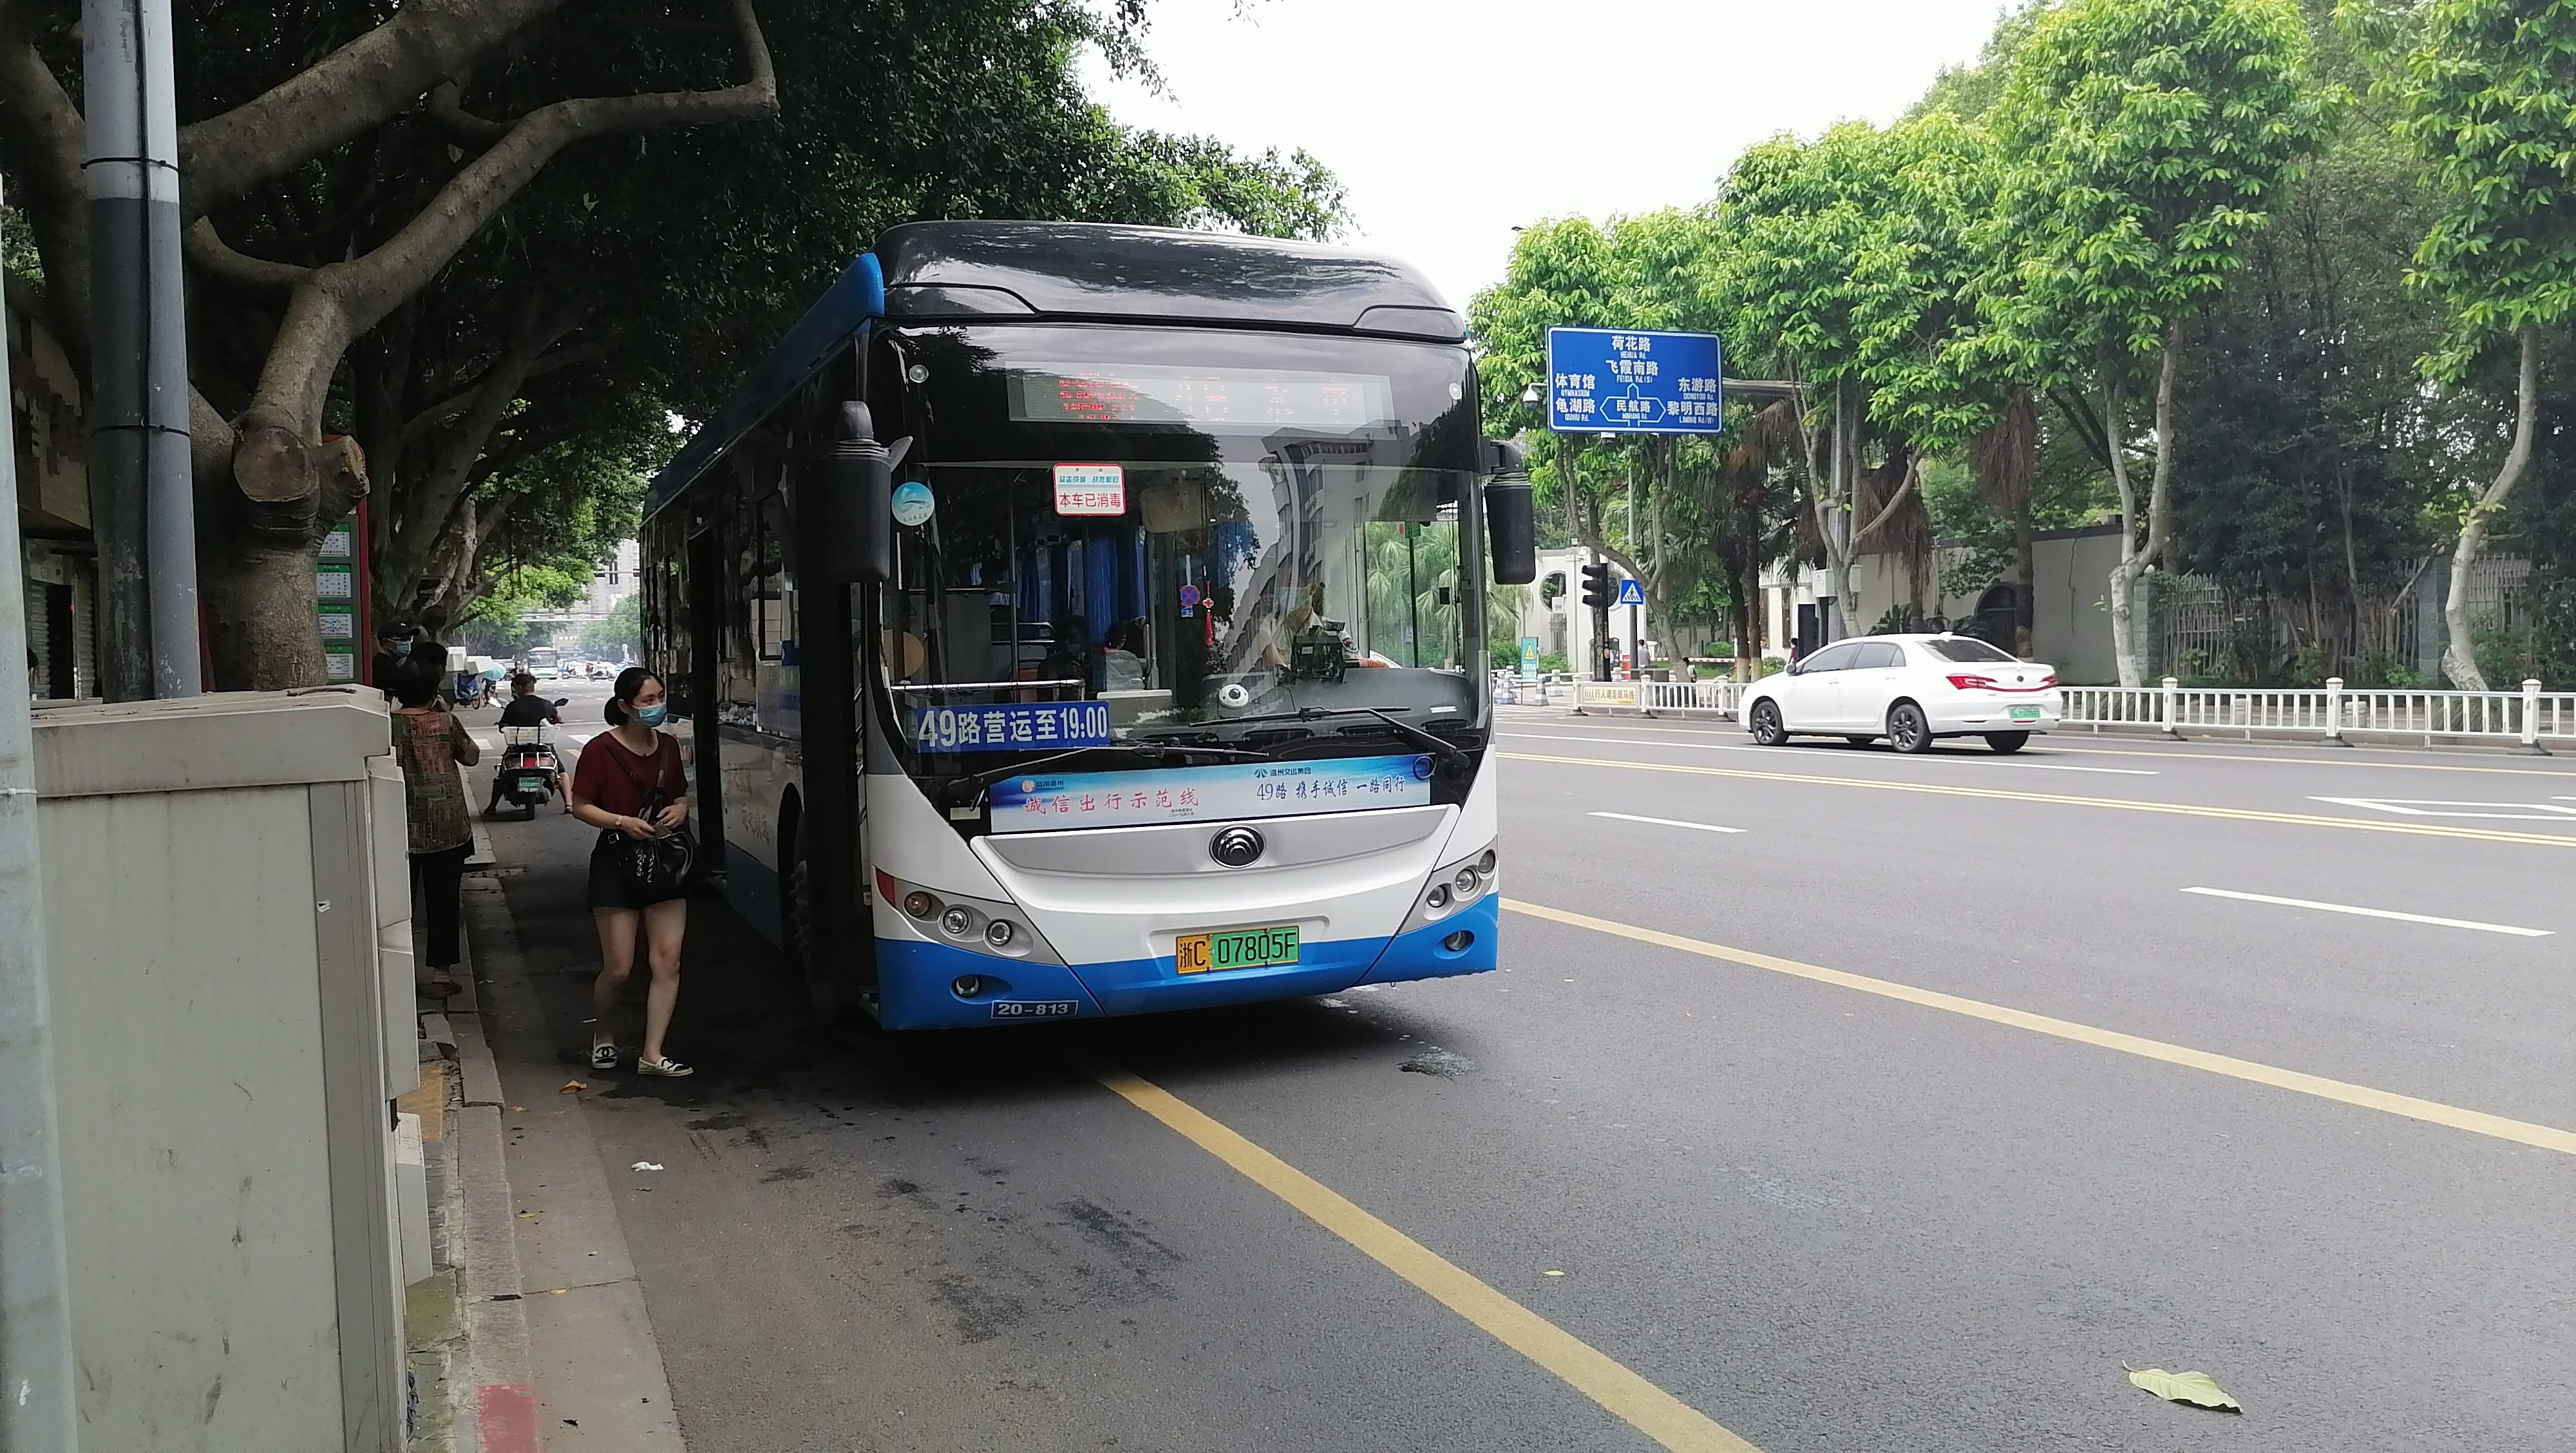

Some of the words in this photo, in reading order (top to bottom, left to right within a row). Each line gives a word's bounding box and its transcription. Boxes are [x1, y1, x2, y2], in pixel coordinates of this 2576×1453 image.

[1612, 336, 1651, 352] 荷花路
[1605, 360, 1658, 376] 飞霞南路
[1555, 372, 1595, 390] 体育馆
[1678, 377, 1717, 393] 东游路
[1555, 397, 1595, 414] 龟湖路
[1616, 400, 1651, 413] 民航路
[1667, 401, 1718, 417] 黎明西路
[1059, 492, 1121, 508] 本车已消毒
[1595, 689, 1634, 700] 行人请走斑马线
[918, 706, 1108, 747] 49路营运至19:00
[1270, 767, 1311, 777] 温州交运集团
[1256, 782, 1287, 801] 49路
[1296, 779, 1348, 799] 携手诚信
[1356, 775, 1405, 793] 一路同行
[1023, 787, 1199, 815] 诚信出行示范线
[998, 1003, 1068, 1016] 20-813
